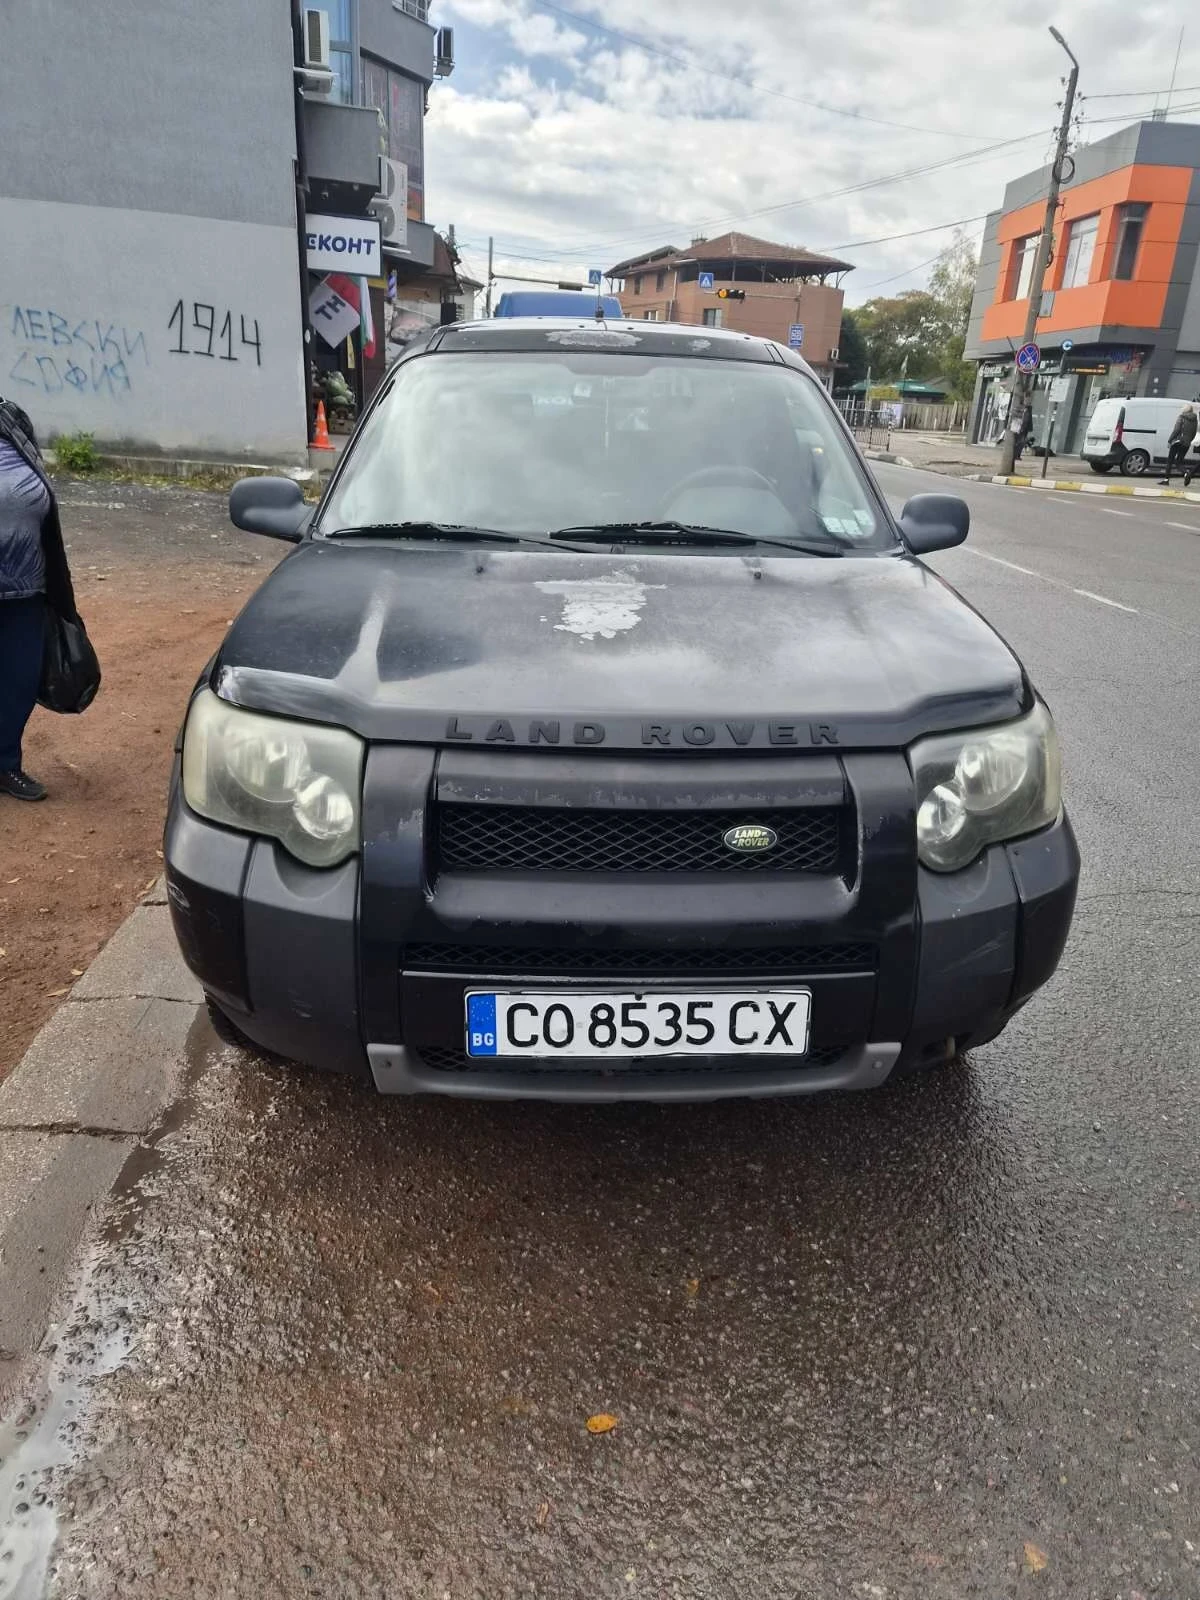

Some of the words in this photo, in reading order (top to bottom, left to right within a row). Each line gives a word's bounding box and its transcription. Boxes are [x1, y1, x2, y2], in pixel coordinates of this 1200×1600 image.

[12, 305, 150, 366] ЛЕВСКИ
[167, 299, 262, 366] 1914
[447, 717, 605, 745] LAND
[642, 720, 840, 746] ROVER
[472, 1033, 495, 1047] BG
[506, 1002, 575, 1048] CO
[588, 1001, 715, 1048] 8535
[728, 1000, 798, 1046] CX
